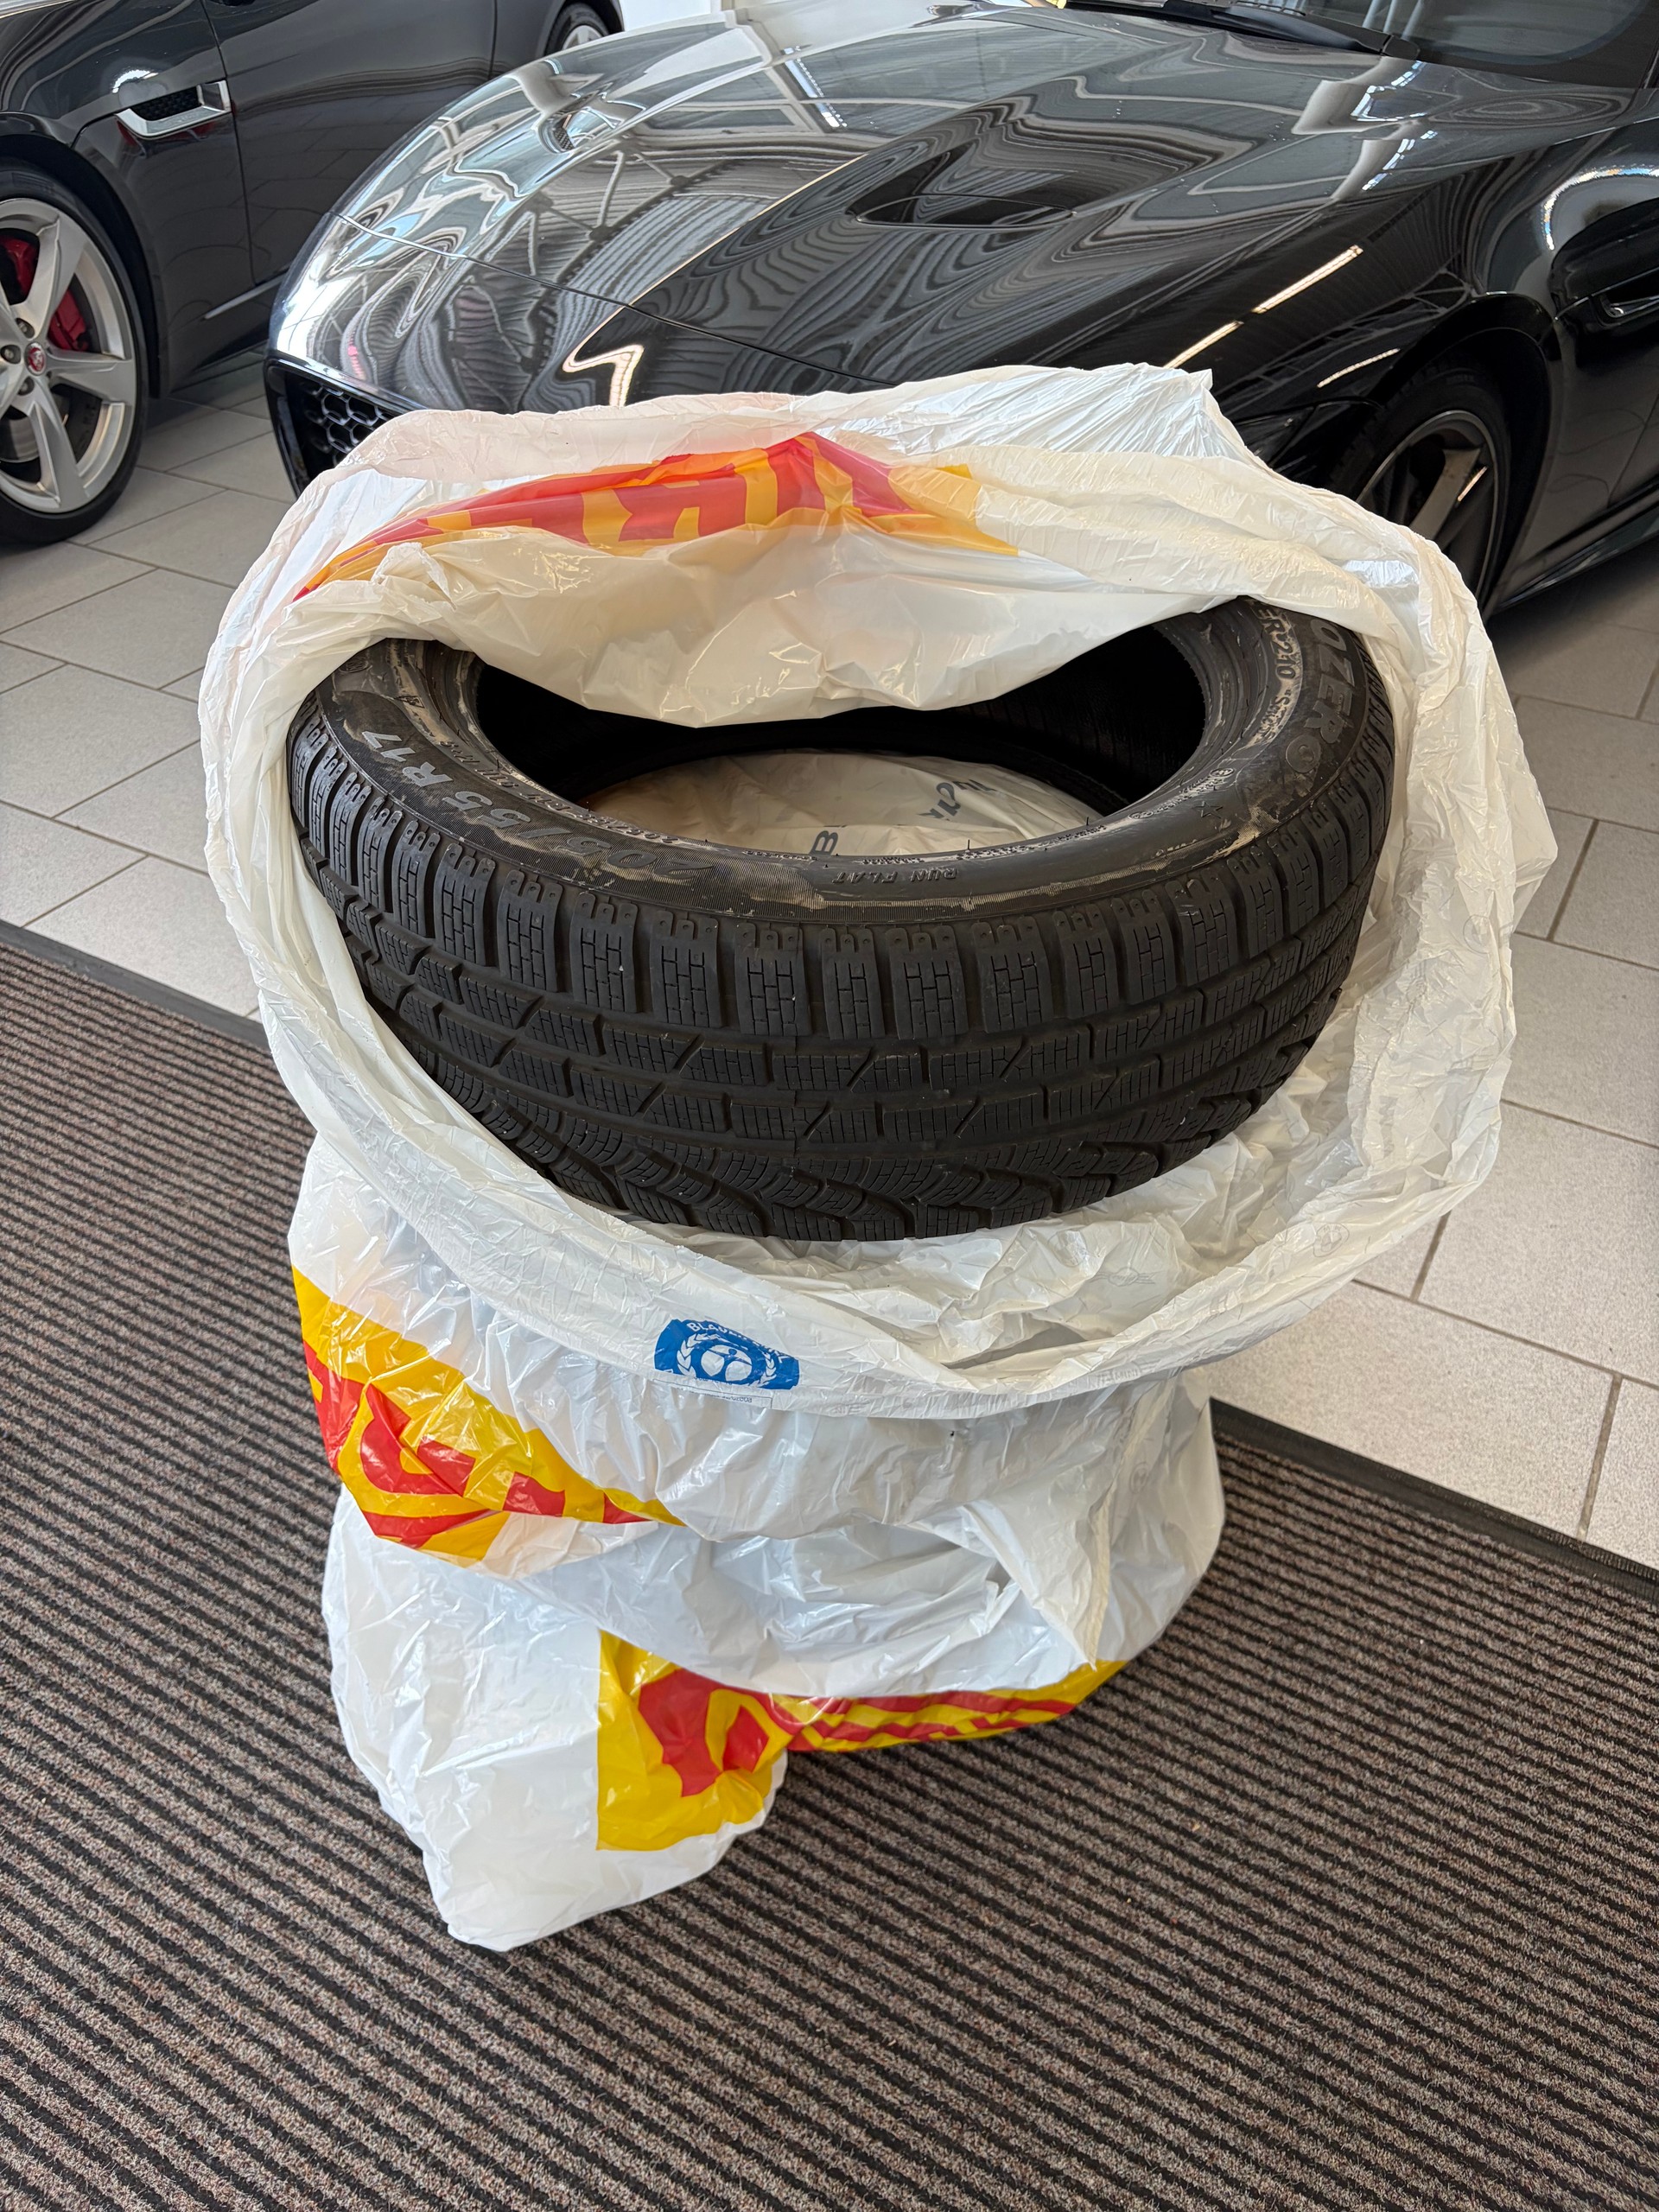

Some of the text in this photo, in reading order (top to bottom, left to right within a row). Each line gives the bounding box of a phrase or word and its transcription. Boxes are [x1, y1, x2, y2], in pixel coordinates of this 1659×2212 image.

[1272, 641, 1296, 679] 210
[442, 791, 715, 880] 205/55
[831, 867, 957, 884] RUN FLAT
